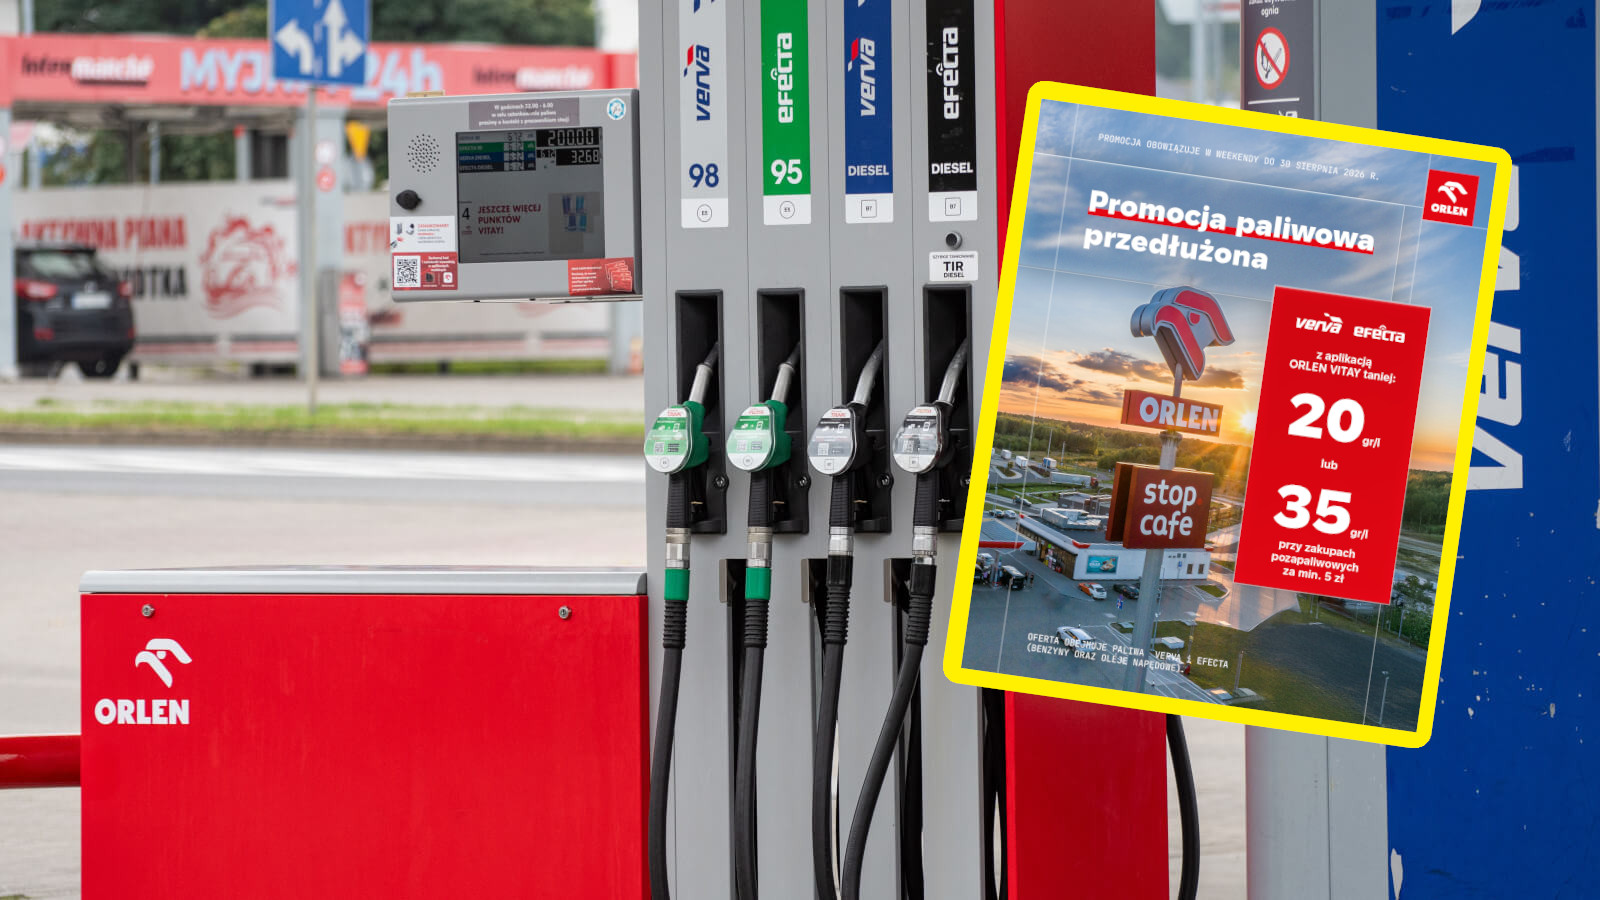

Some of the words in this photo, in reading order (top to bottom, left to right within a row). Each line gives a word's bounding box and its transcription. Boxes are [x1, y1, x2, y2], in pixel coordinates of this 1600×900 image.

[1261, 6, 1279, 18] ognia
[692, 44, 711, 121] verva
[858, 38, 875, 117] verva
[771, 159, 803, 184] 95
[848, 165, 889, 177] DIESEL
[931, 162, 973, 175] DIESEL
[689, 163, 719, 188] 98
[462, 208, 470, 220] 4
[478, 205, 510, 214] JESZCZE
[513, 203, 541, 213] WIĘCEJ
[478, 214, 520, 224] PUNKTÓW
[478, 226, 504, 235] VITAY!
[943, 261, 964, 272] TIR
[94, 698, 190, 725] ORLEN
